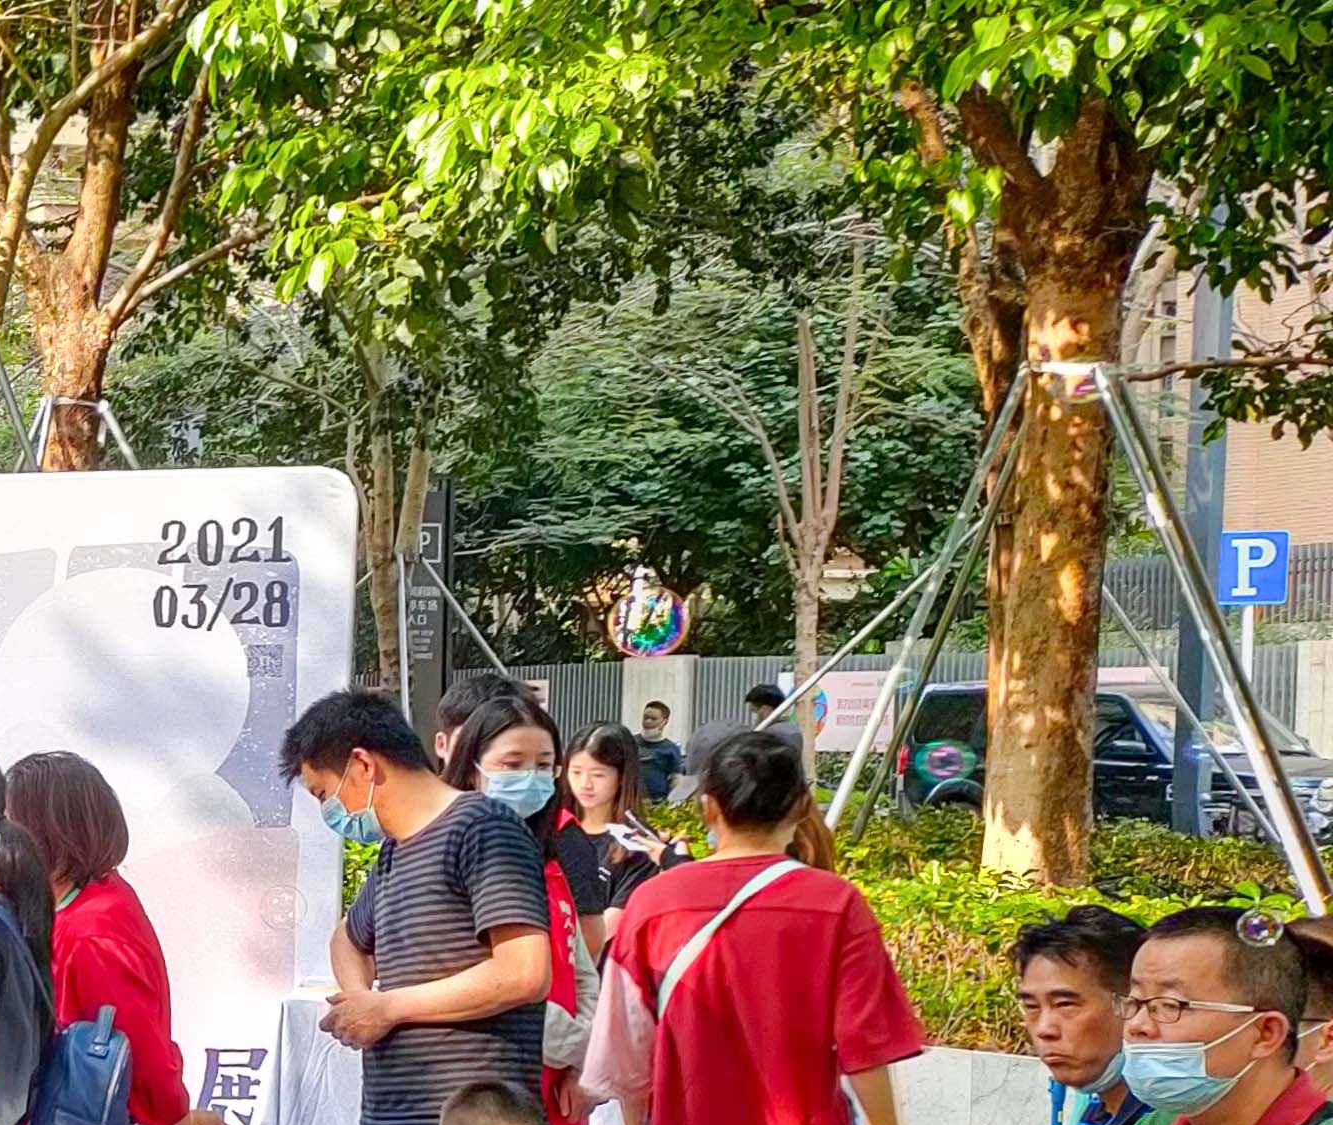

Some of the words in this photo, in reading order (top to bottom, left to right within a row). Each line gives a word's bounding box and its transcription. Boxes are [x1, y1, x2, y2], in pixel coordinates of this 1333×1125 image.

[157, 516, 293, 566] 2021
[1231, 538, 1277, 597] P
[153, 576, 290, 631] 03/28
